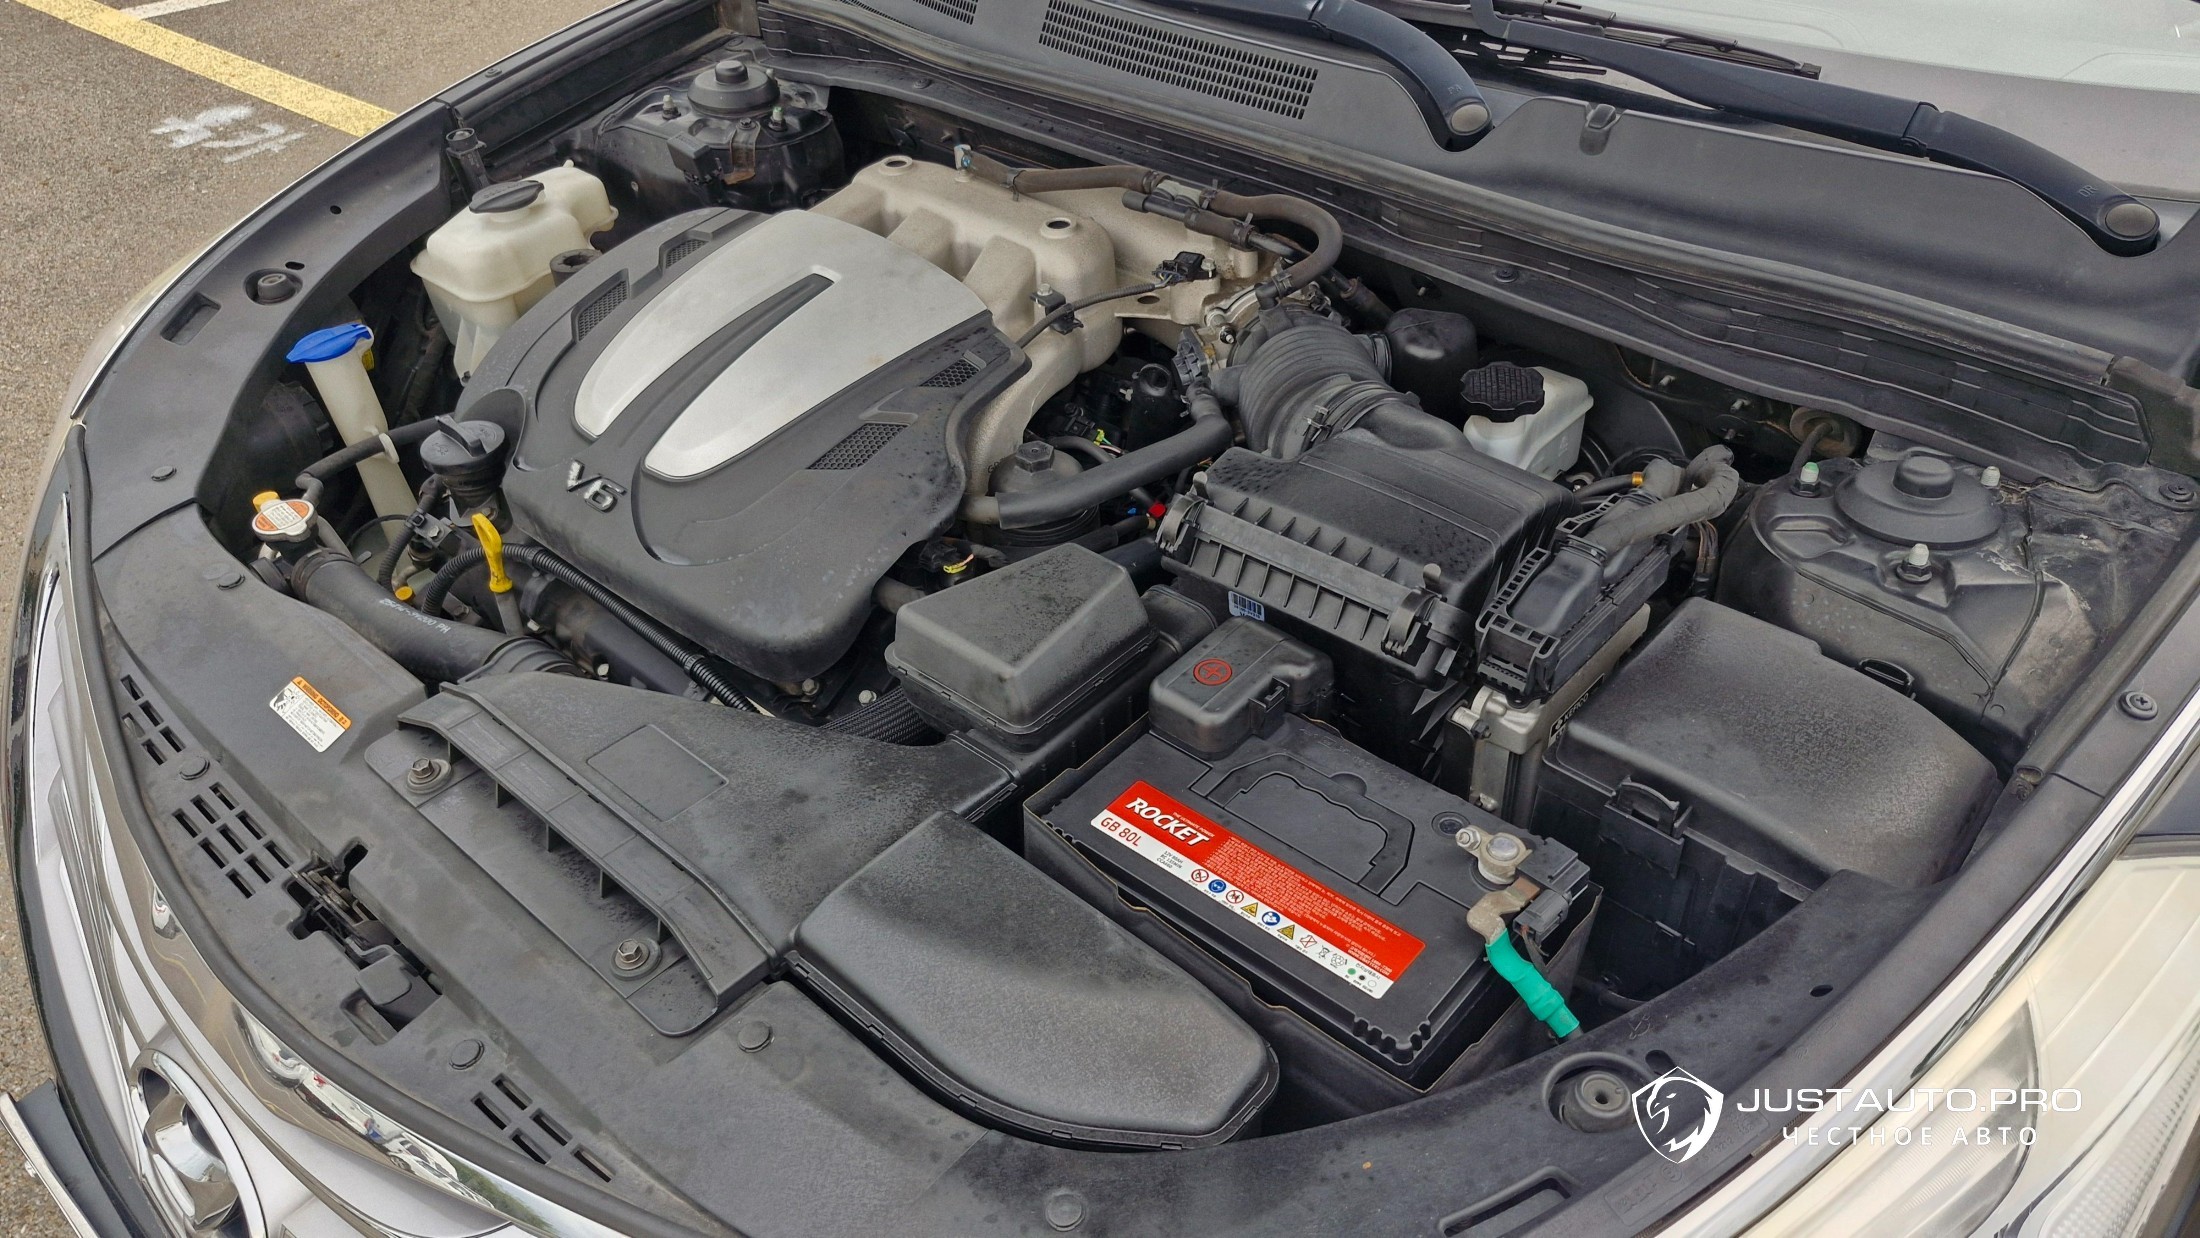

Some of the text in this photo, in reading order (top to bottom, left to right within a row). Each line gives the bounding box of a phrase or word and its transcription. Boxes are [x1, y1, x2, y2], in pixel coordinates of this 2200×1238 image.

[566, 459, 628, 514] V6
[1100, 817, 1142, 847] GB 80L
[1125, 797, 1210, 846] ROCKET
